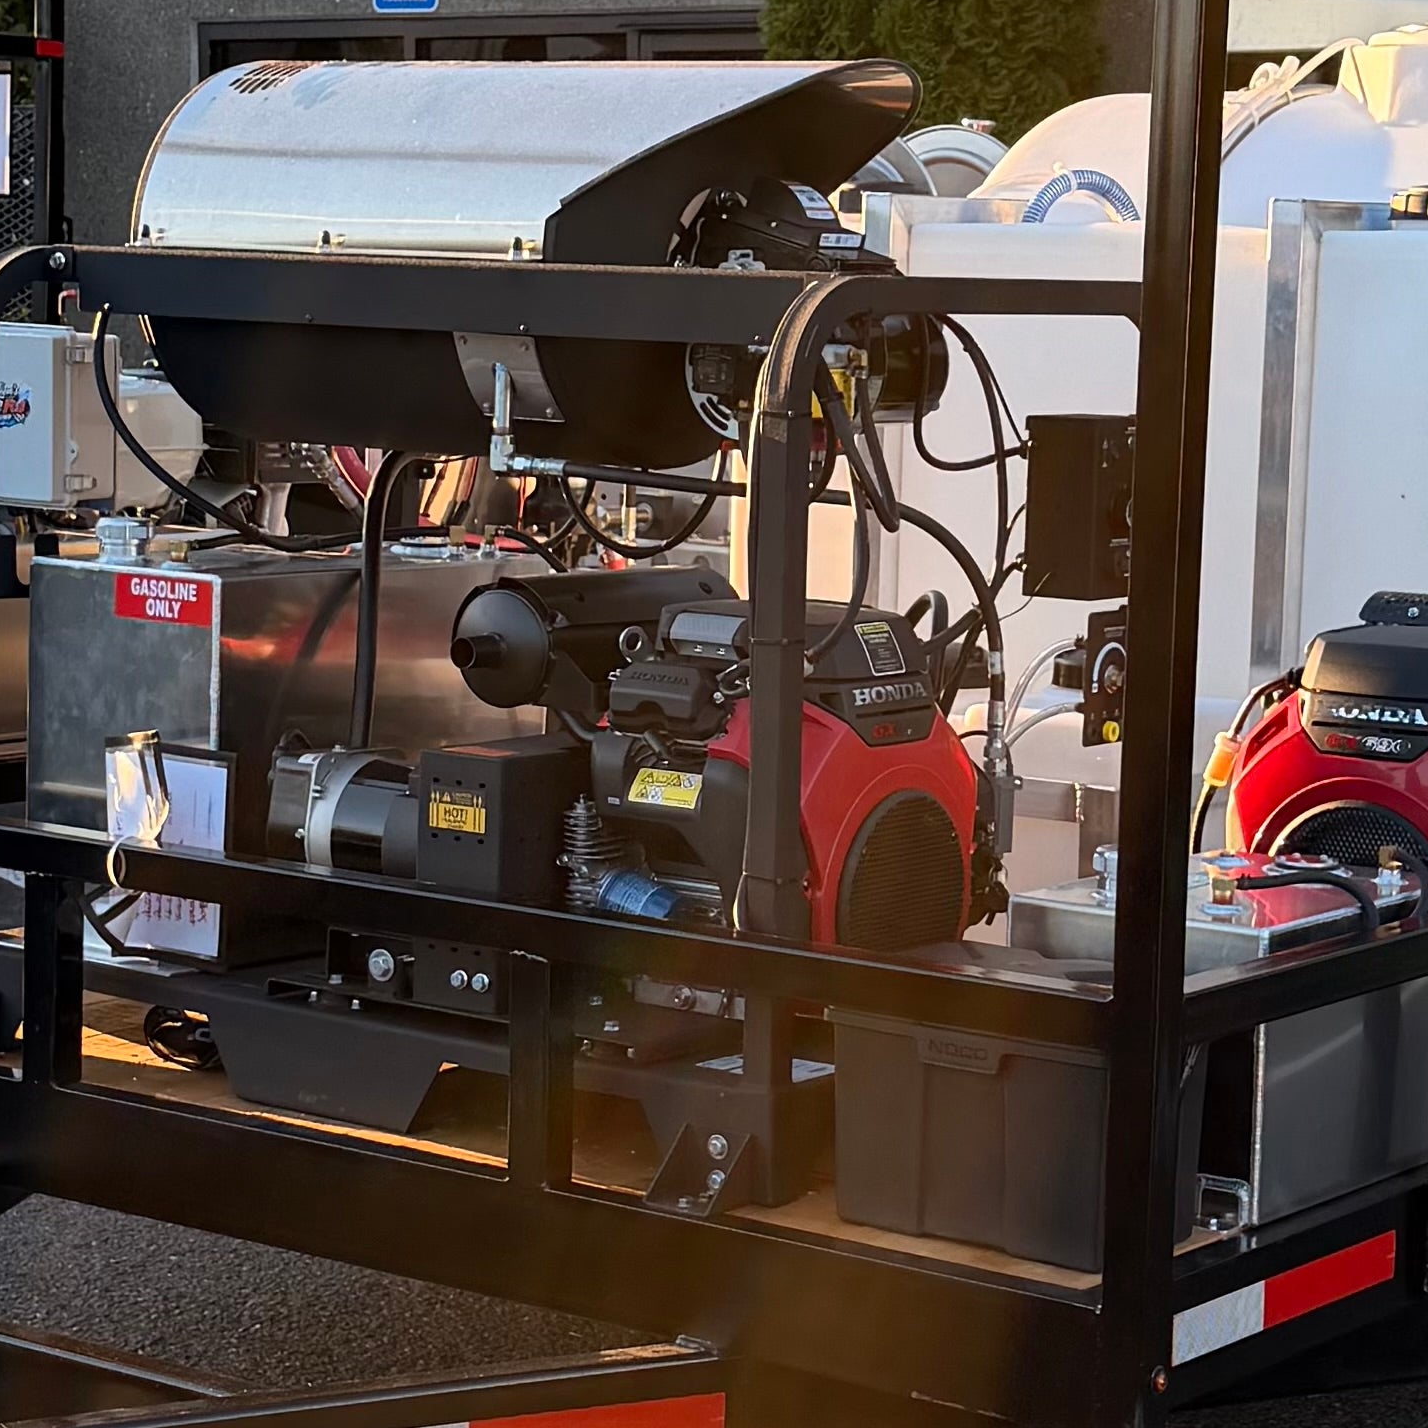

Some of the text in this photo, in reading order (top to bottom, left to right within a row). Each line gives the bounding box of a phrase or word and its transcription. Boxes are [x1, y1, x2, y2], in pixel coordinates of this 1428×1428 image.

[131, 577, 198, 602] GASOLINE
[145, 598, 181, 619] ONLY
[852, 681, 928, 707] HONDA
